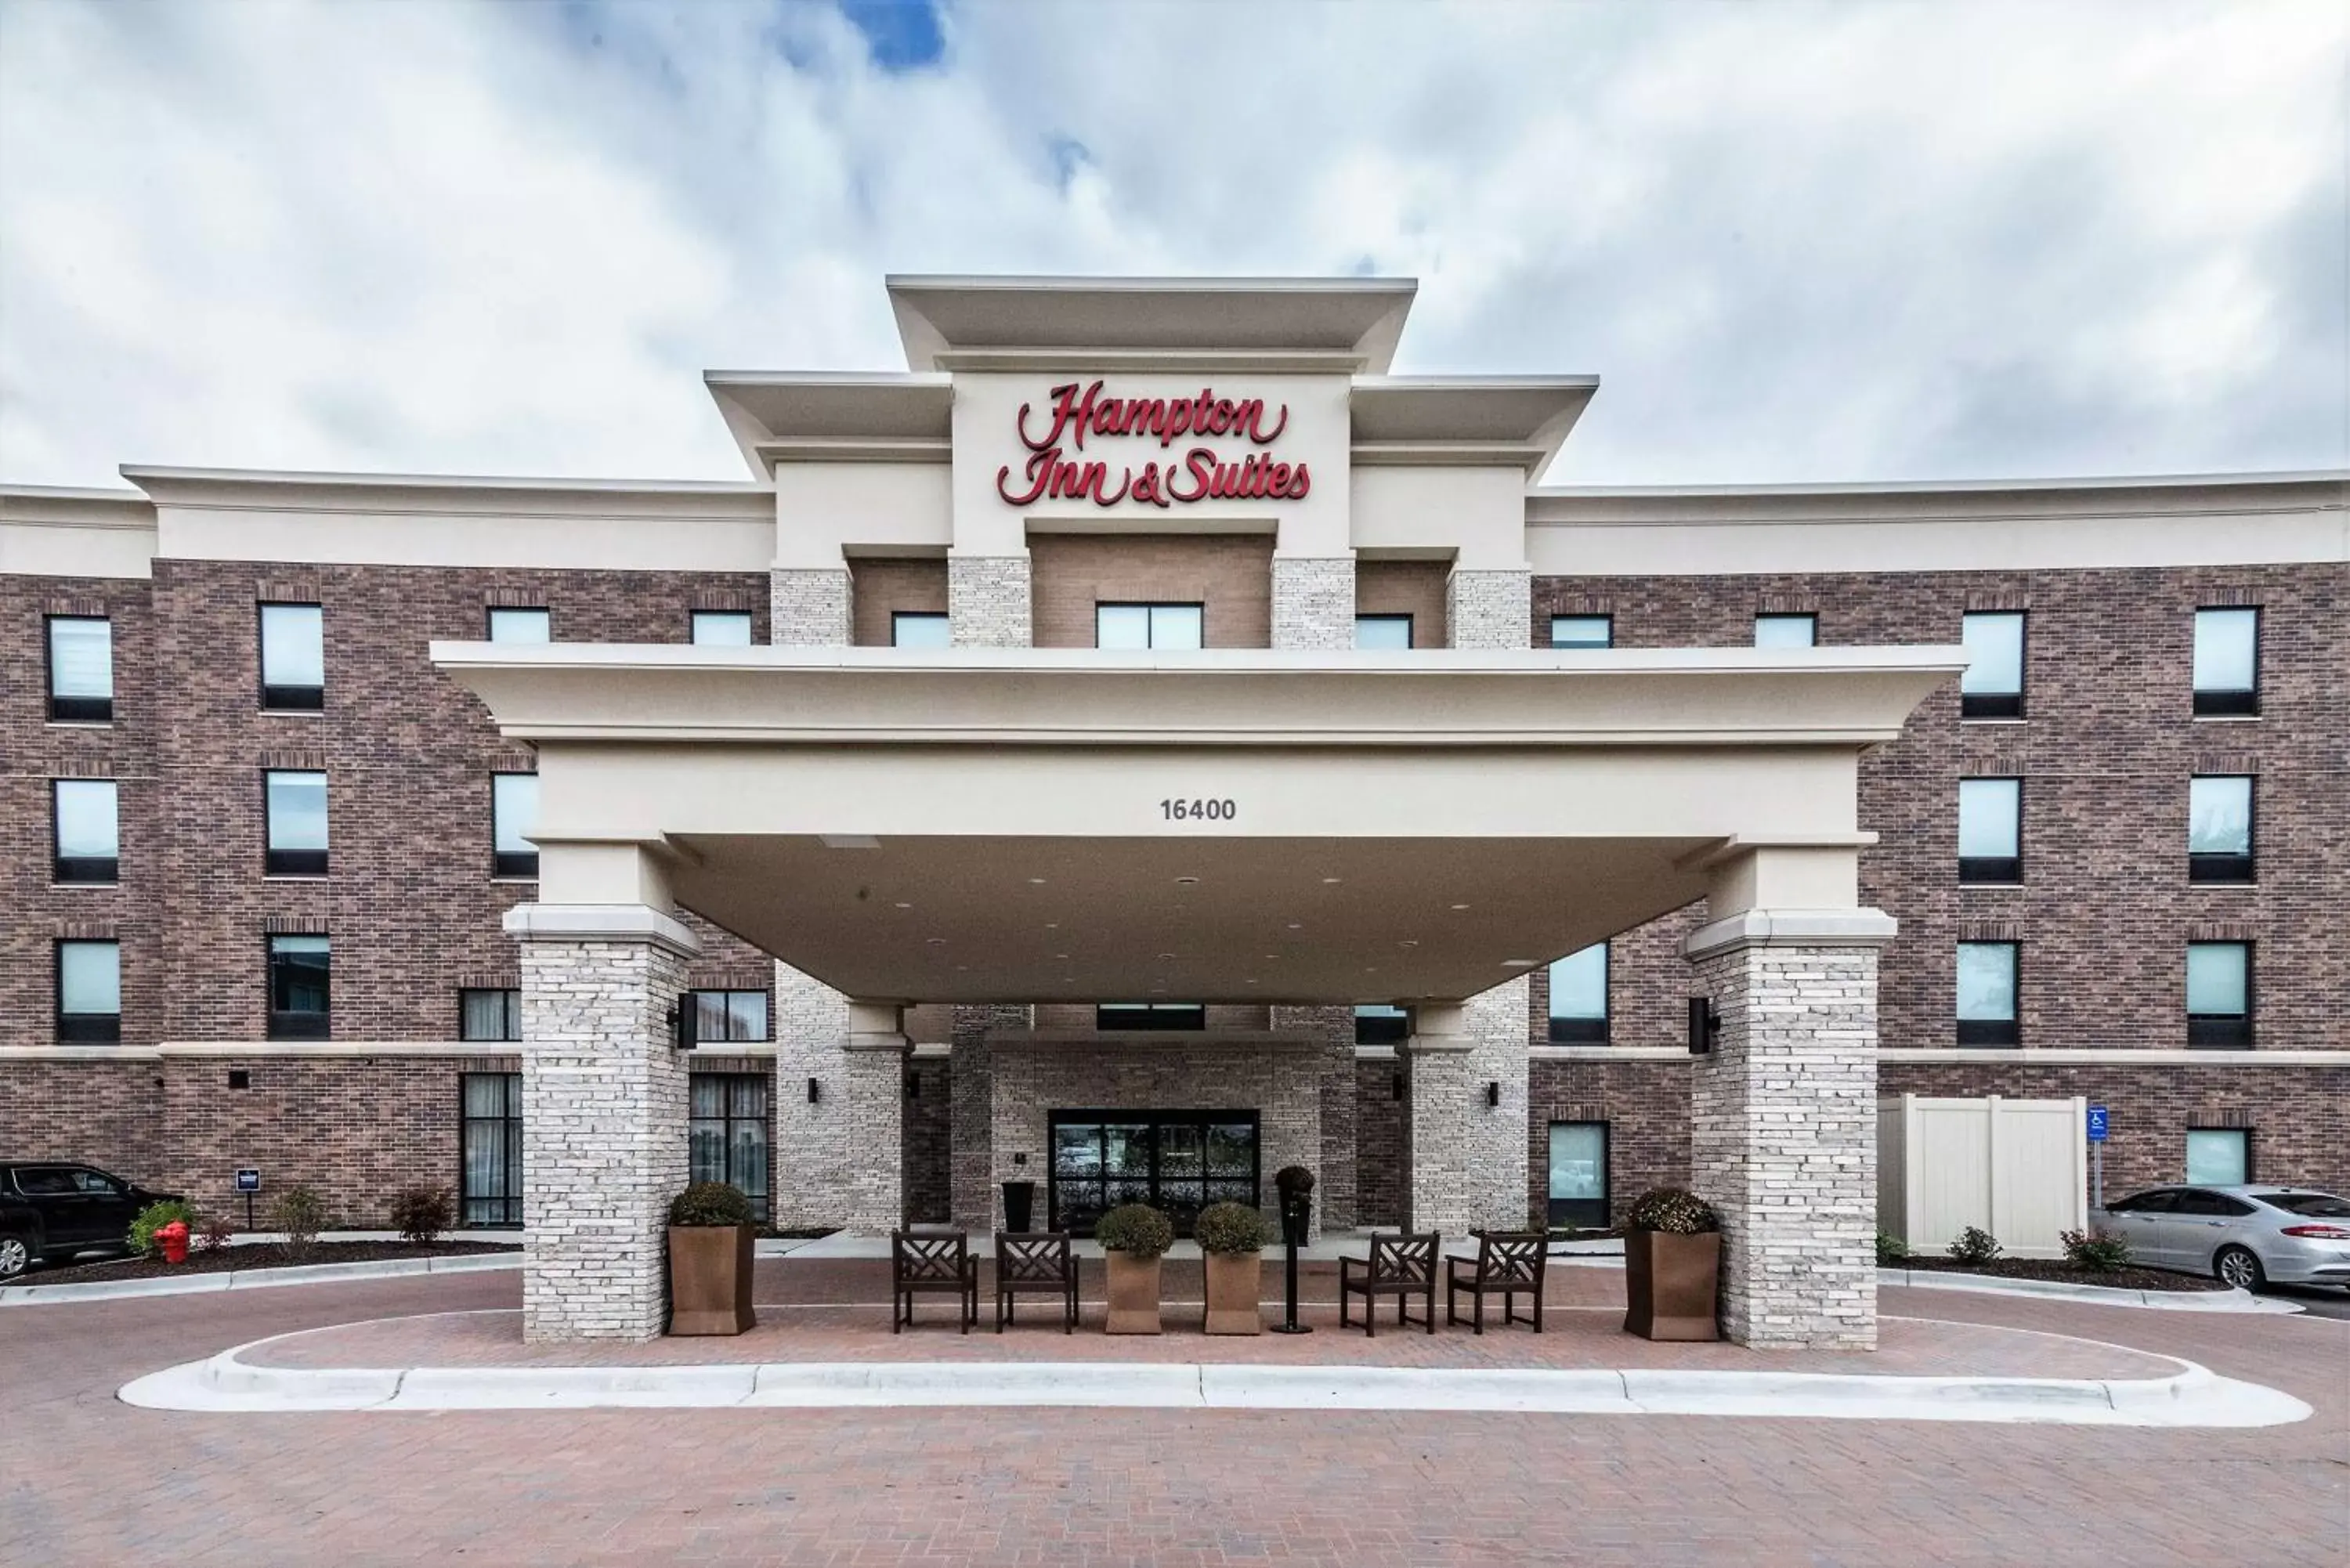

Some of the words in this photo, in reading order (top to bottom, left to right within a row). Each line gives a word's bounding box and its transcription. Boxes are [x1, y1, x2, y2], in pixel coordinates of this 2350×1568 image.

[1018, 380, 1288, 451] Hampton
[997, 447, 1131, 507] Inn
[1132, 461, 1170, 508] &
[1166, 447, 1311, 500] Suites
[1160, 799, 1236, 820] 16400
